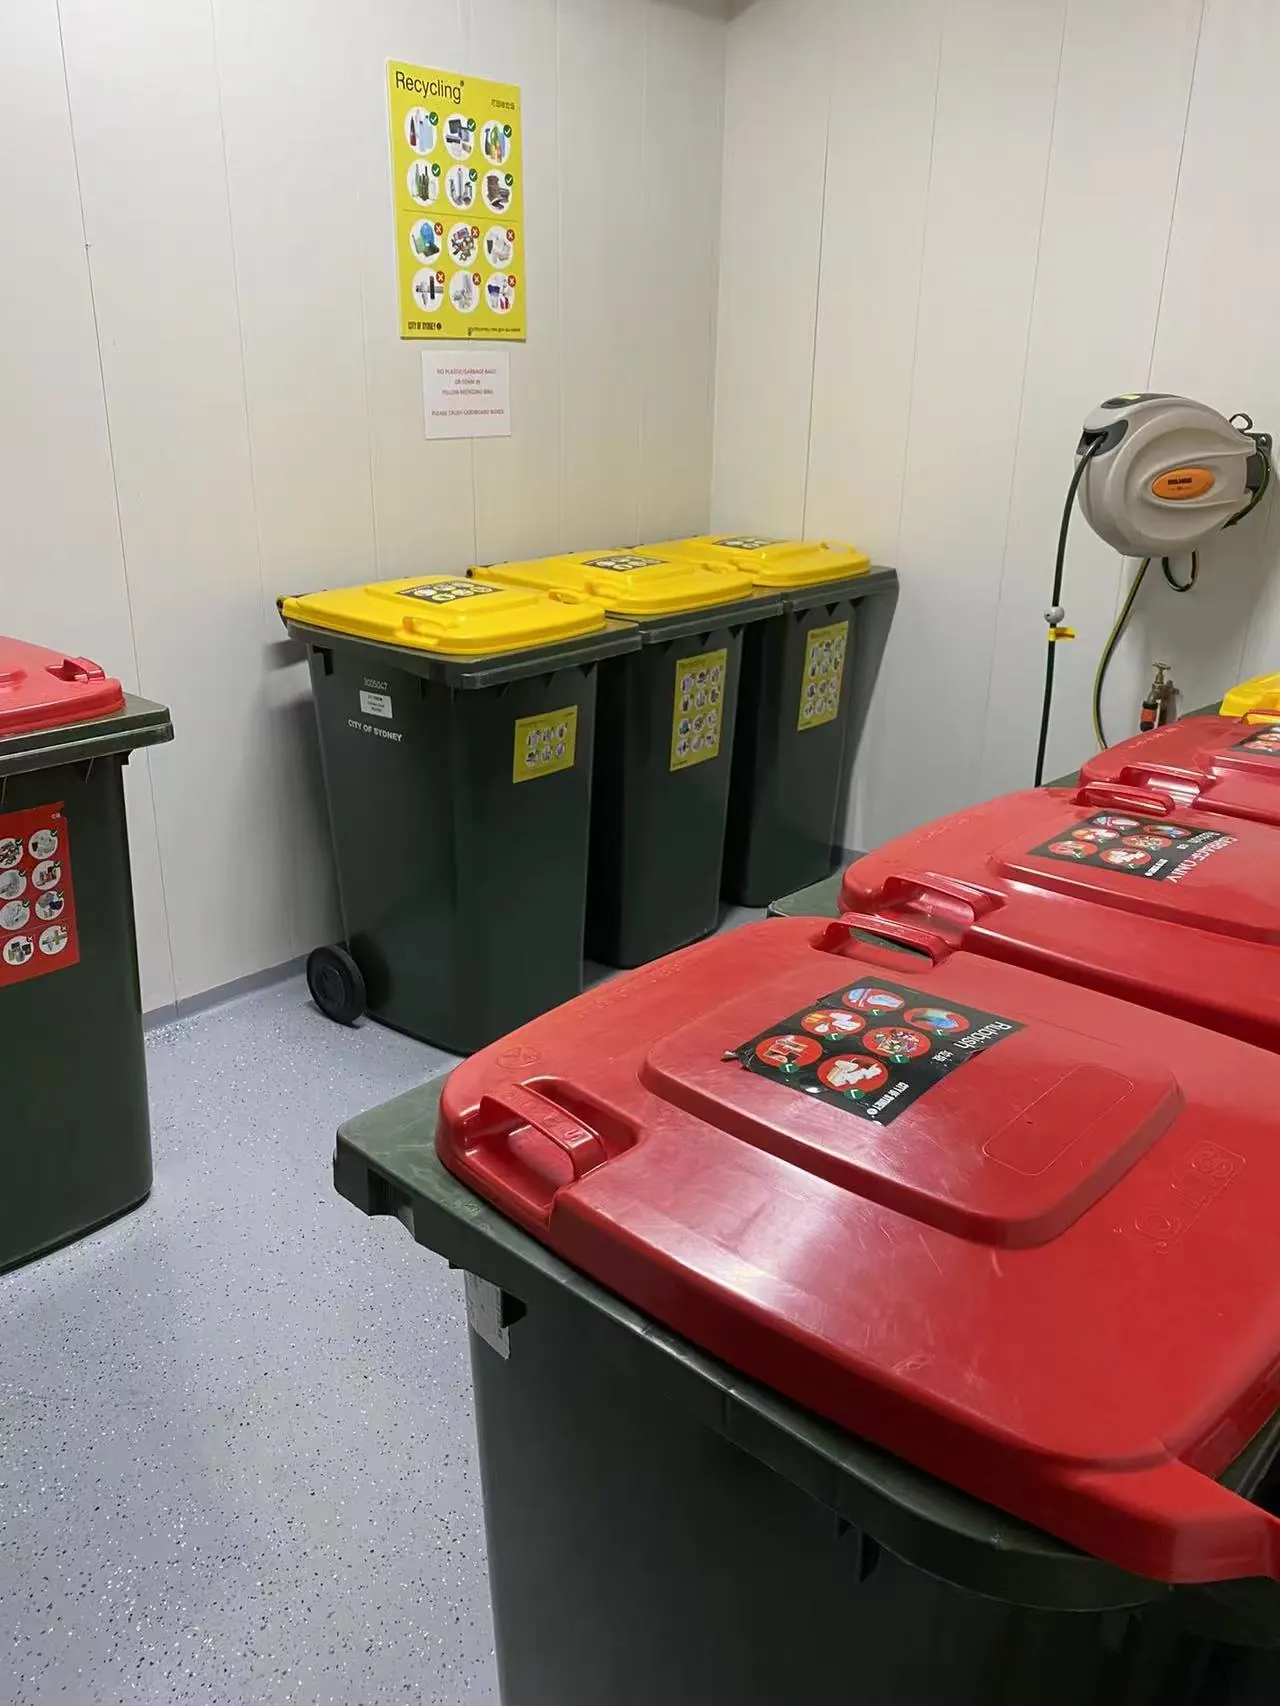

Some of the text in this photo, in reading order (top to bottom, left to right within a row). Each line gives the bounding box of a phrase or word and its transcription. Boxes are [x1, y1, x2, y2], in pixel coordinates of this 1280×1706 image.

[395, 70, 461, 104] Recycling
[348, 719, 402, 742] CITY OF SYDNEY
[953, 1021, 1013, 1049] Rubbish
